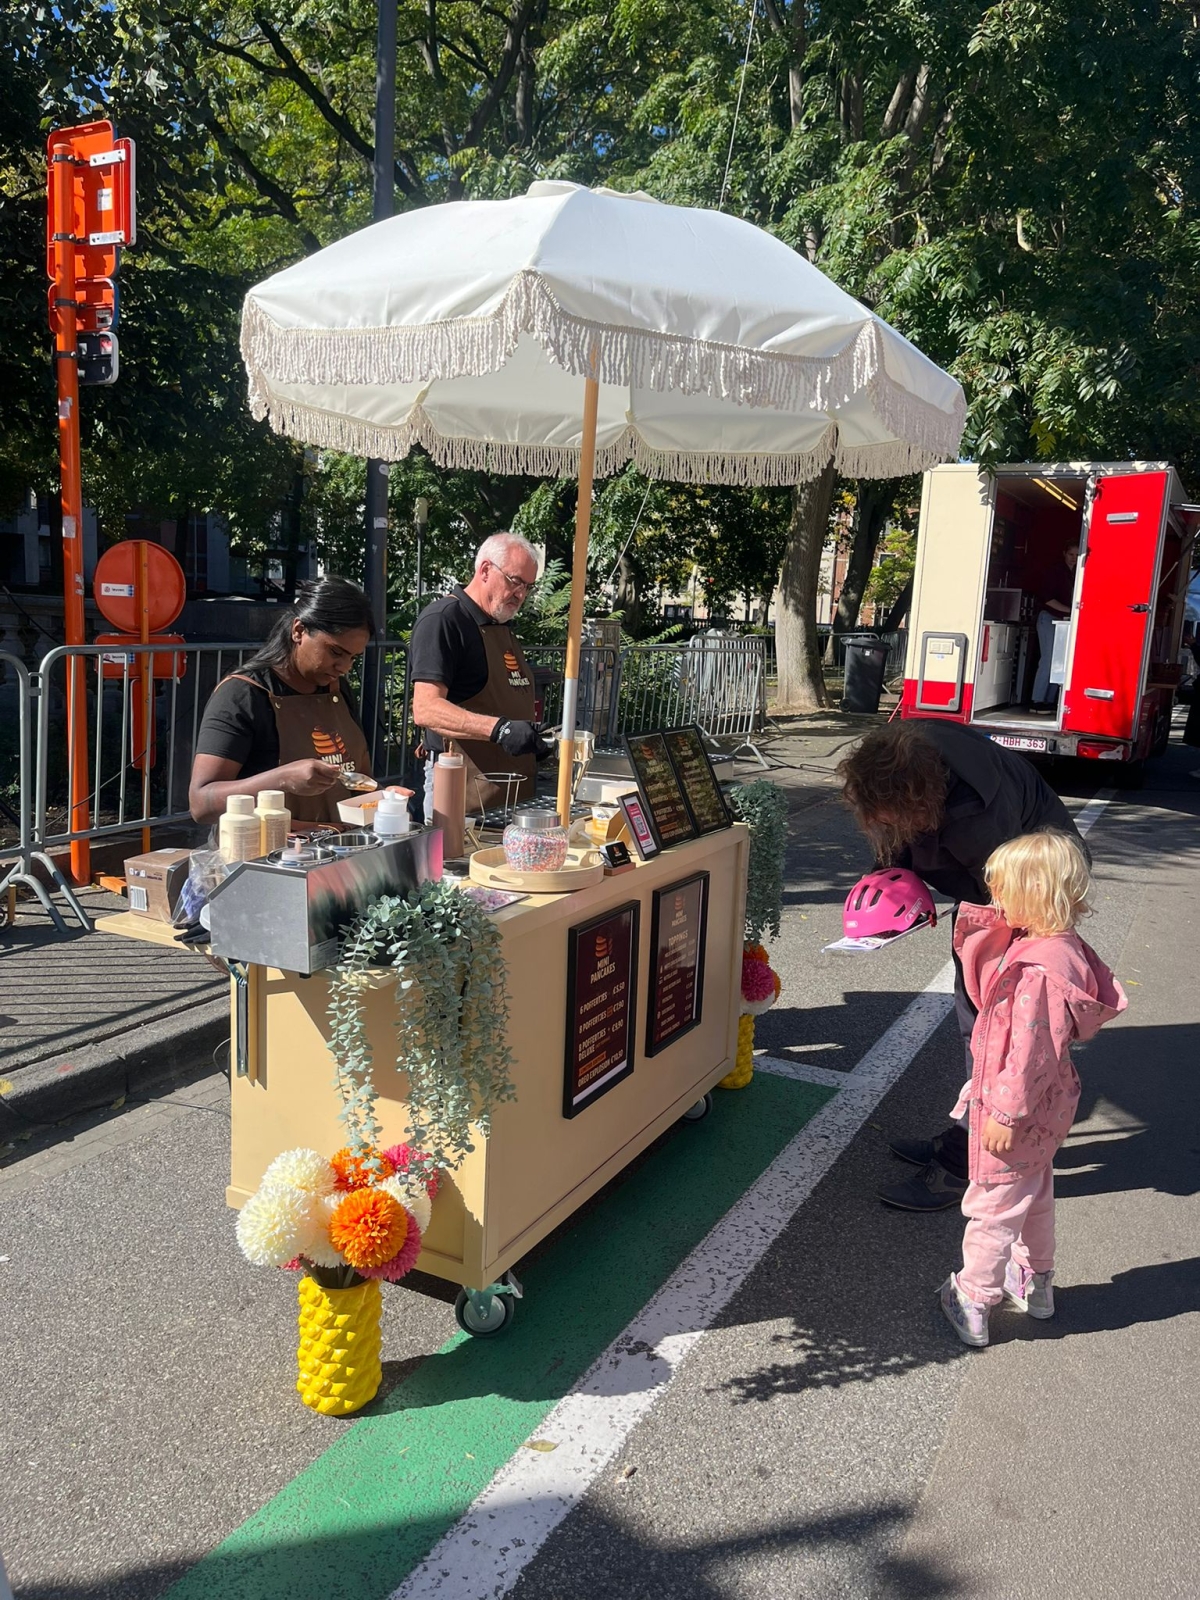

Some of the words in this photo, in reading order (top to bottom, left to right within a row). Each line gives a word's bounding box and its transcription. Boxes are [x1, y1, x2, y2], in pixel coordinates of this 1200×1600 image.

[322, 754, 342, 764] MINI
[668, 930, 688, 946] TOPPINGS
[590, 962, 616, 984] PANCAKES
[597, 956, 610, 970] MINI
[584, 991, 608, 1013] POFFERTJES
[583, 1010, 607, 1032] POFFERTJES
[578, 1044, 595, 1062] DELUXE
[577, 1073, 590, 1088] OREO
[589, 1058, 611, 1080] EXPLOSION
